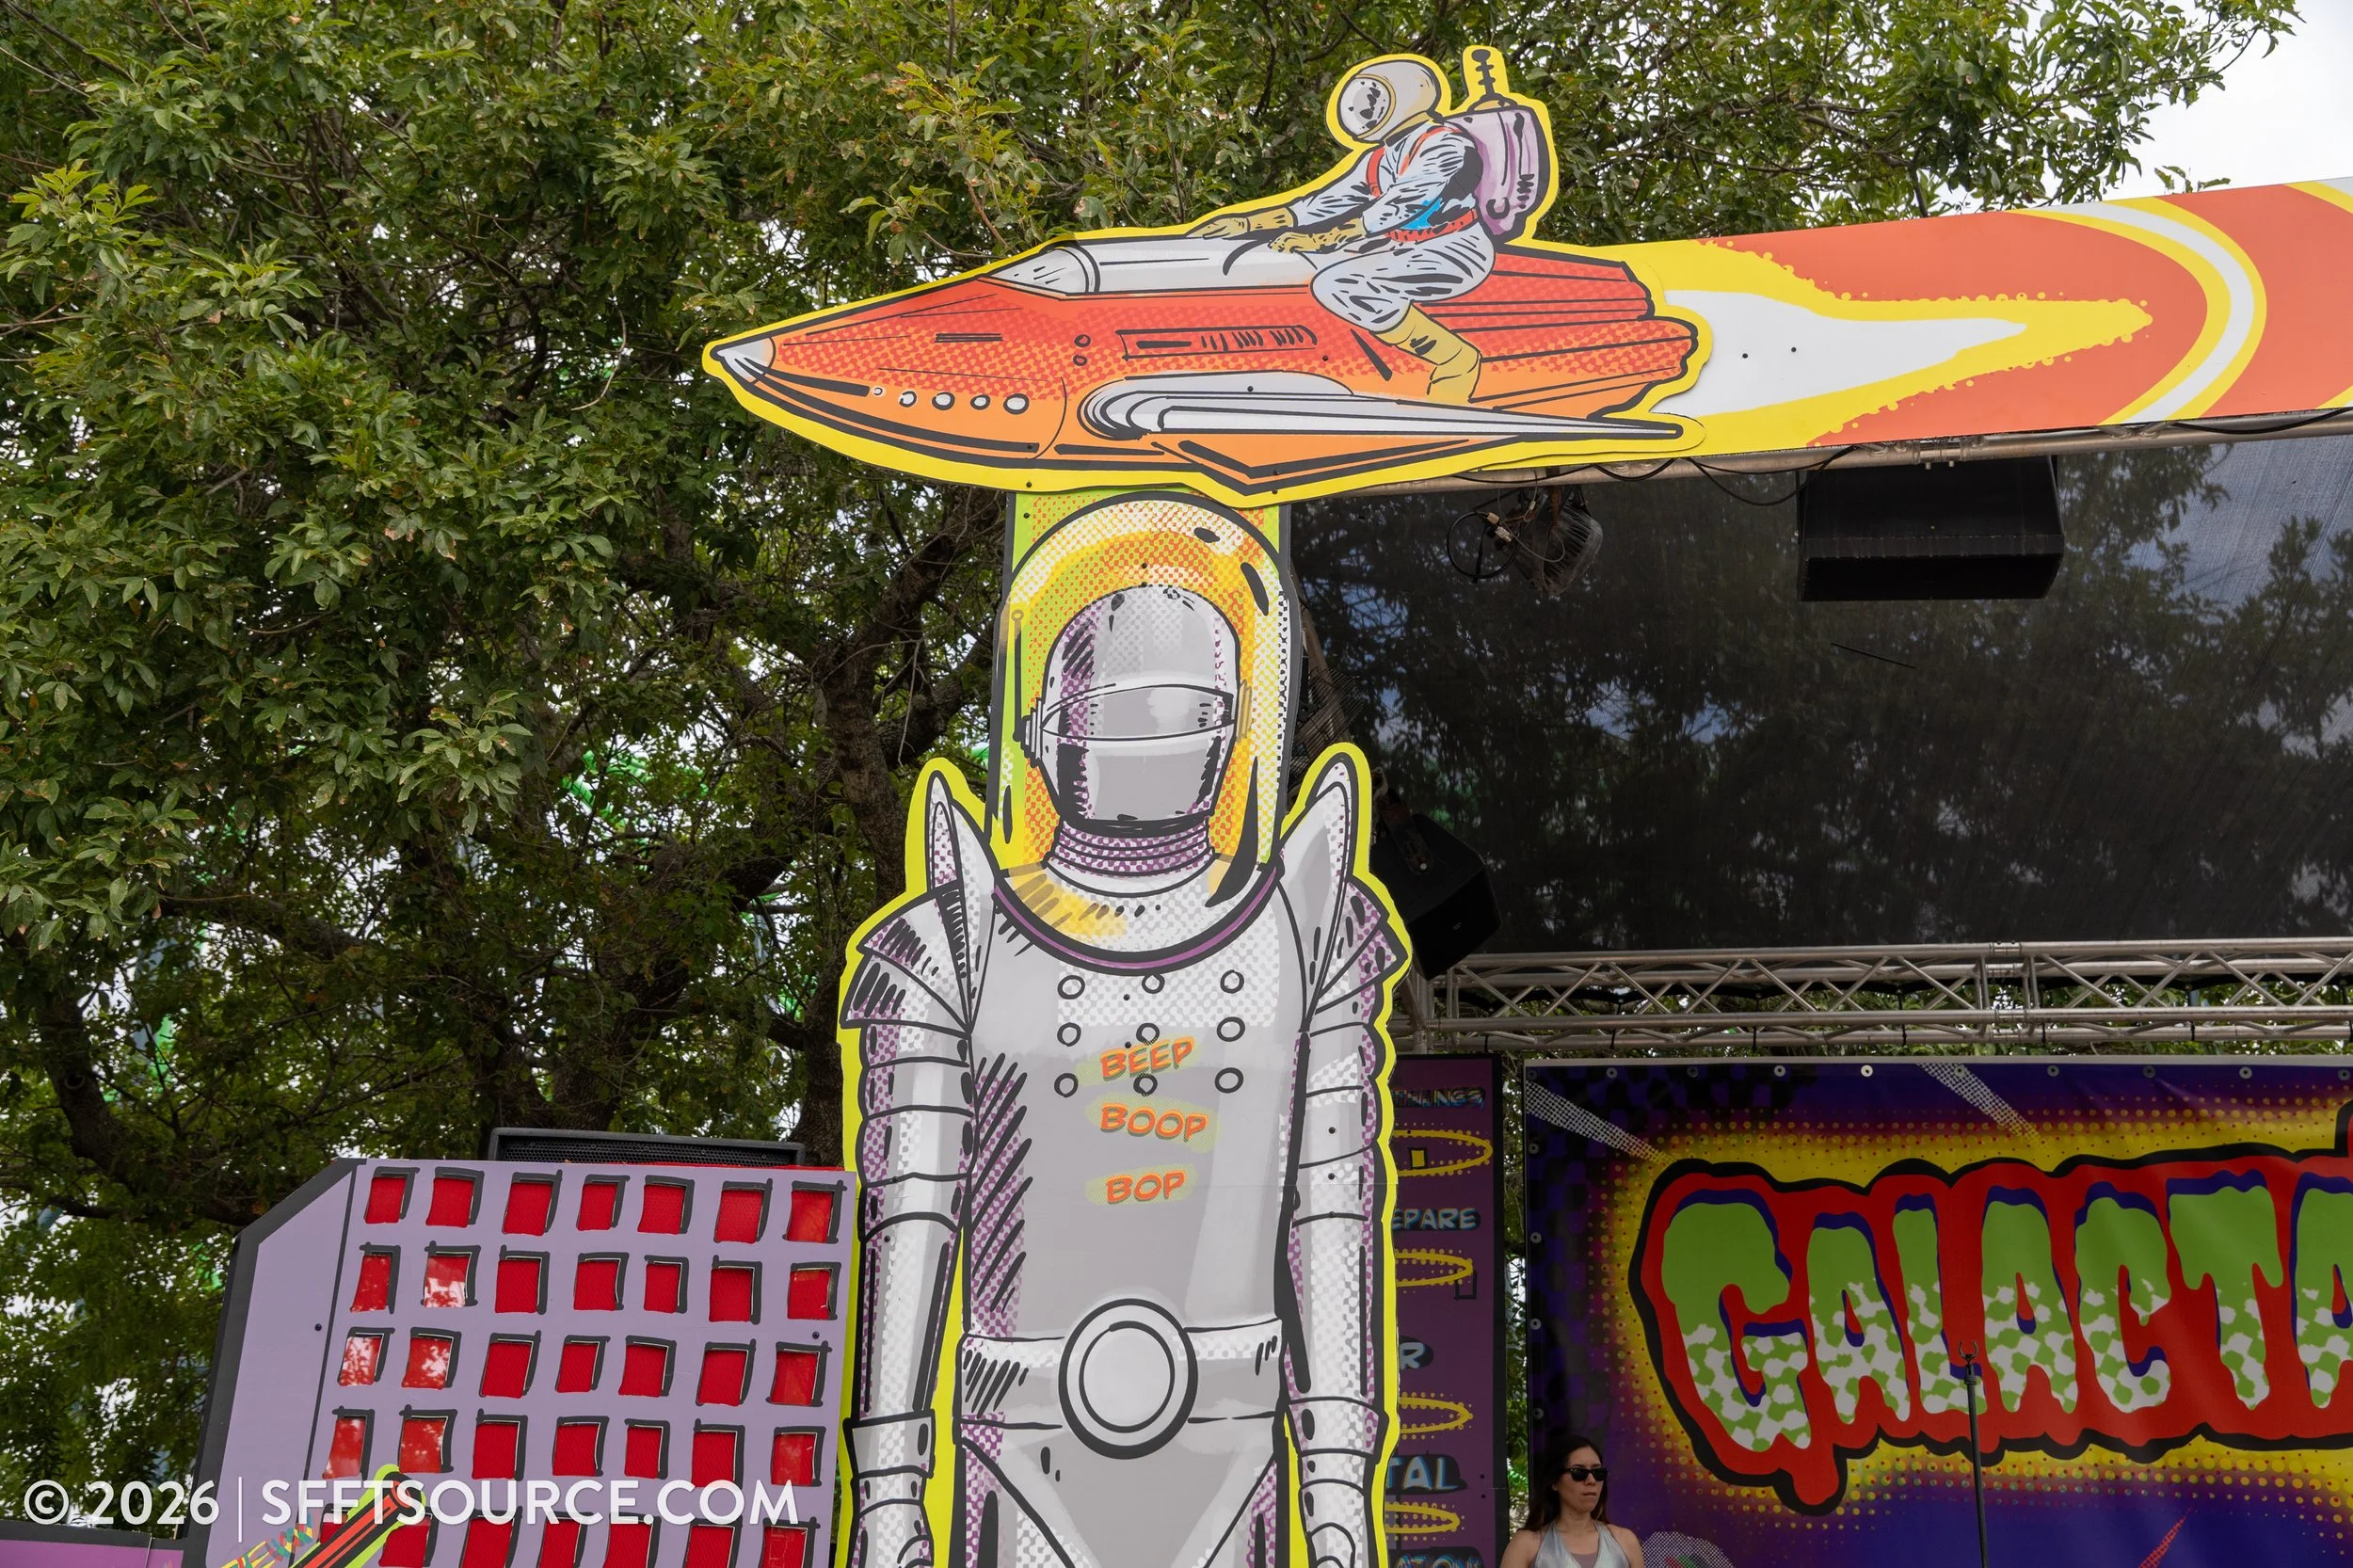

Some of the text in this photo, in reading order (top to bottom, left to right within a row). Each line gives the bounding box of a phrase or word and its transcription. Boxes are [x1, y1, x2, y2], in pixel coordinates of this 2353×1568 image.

[1099, 1035, 1195, 1081] BEEP
[1100, 1102, 1209, 1143] BOOP
[1106, 1170, 1187, 1205] BOP
[1392, 1208, 1477, 1230] EPARE
[1386, 1455, 1459, 1490] TAL
